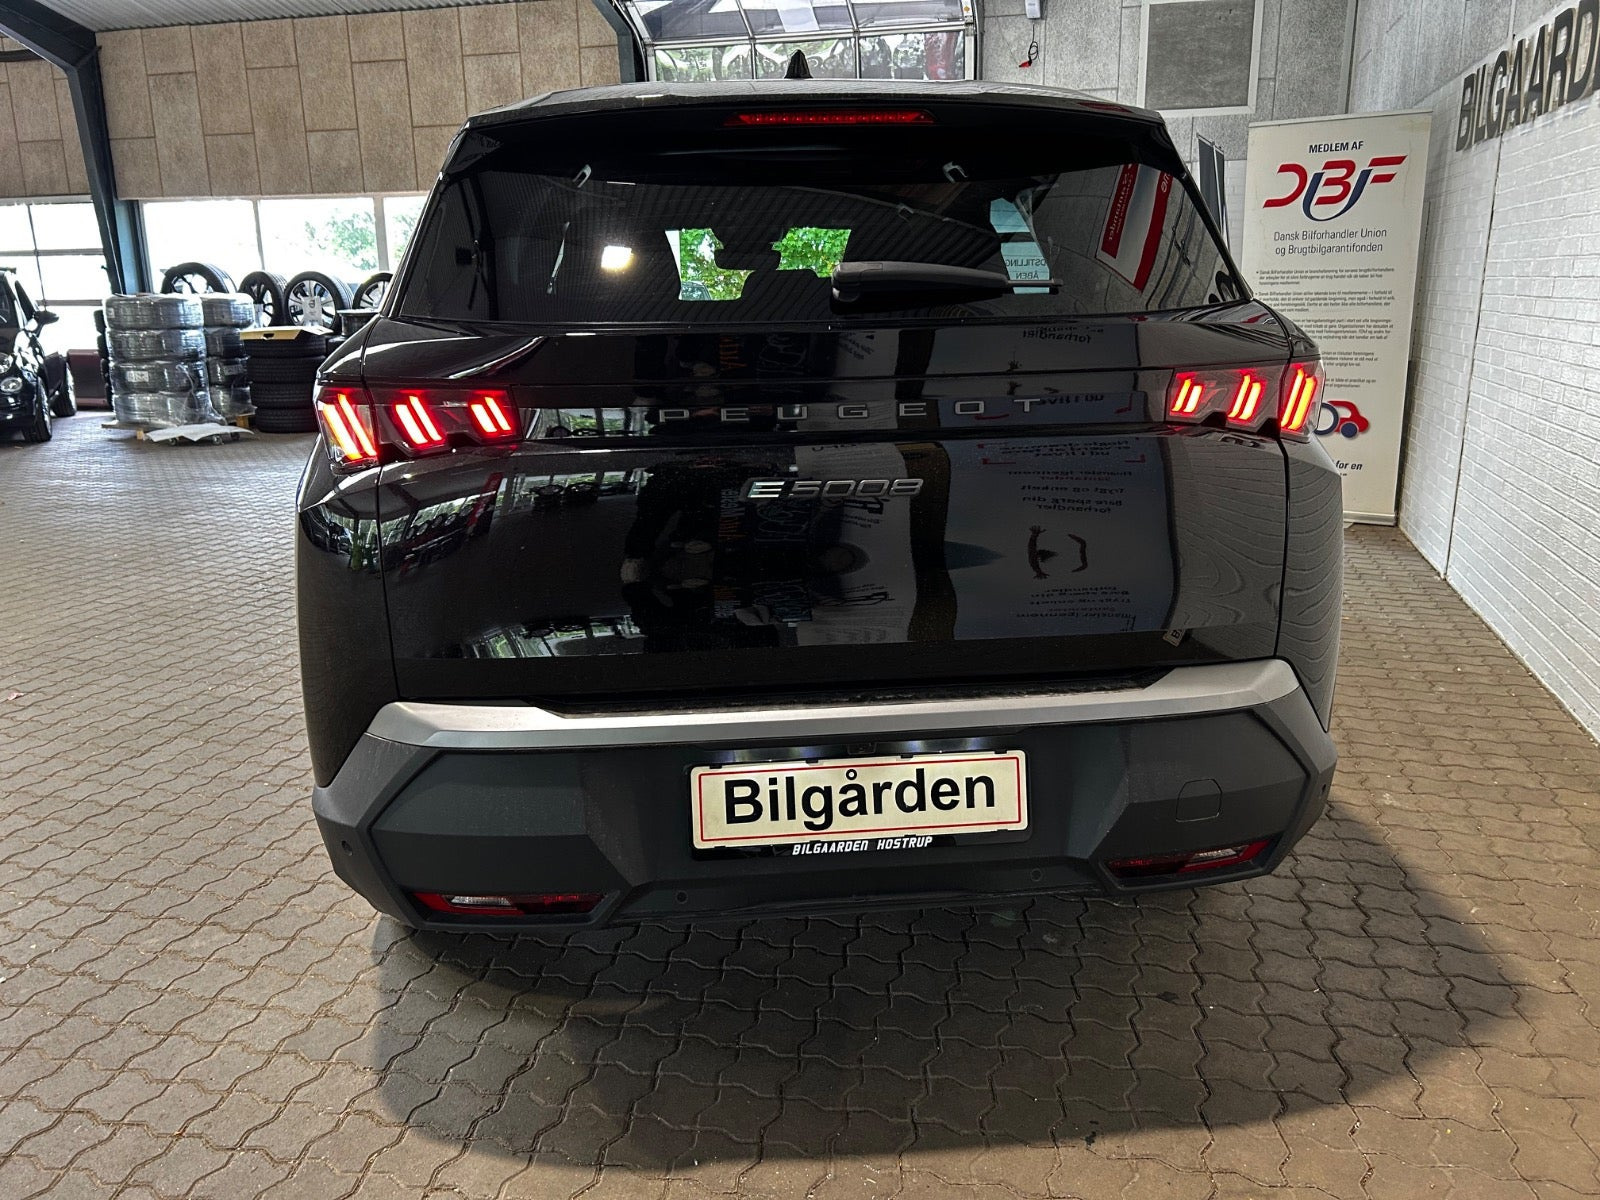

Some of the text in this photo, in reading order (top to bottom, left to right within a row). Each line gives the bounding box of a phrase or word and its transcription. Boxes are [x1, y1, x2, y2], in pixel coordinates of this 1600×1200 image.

[1456, 0, 1600, 152] BILGAARD
[1308, 140, 1364, 154] MEDLEM AF
[1273, 227, 1387, 242] Dansk Bilforhandler Union
[1275, 242, 1383, 257] og Brugtbilgarantifonden
[659, 398, 1041, 423] PEUGEOT
[1350, 462, 1363, 471] en
[724, 768, 996, 831] Bilgården
[792, 836, 933, 856] BILGAARDEN HOSTRUP
